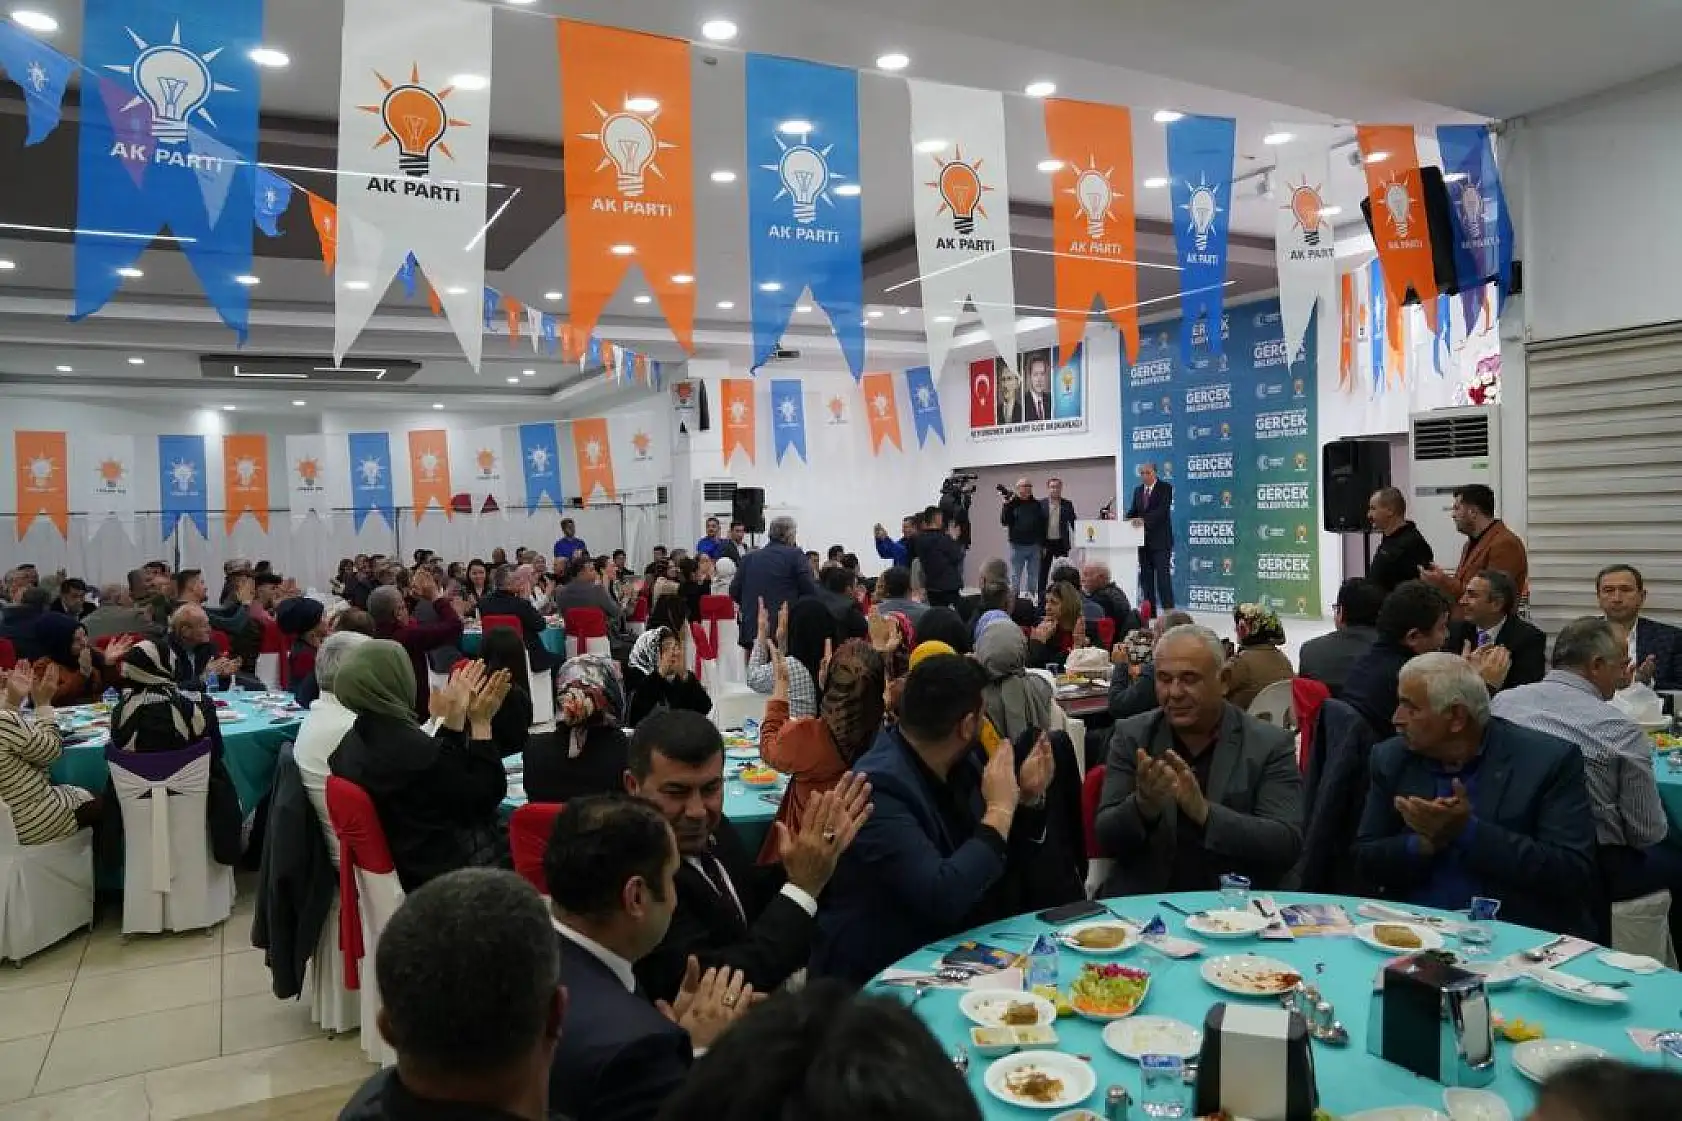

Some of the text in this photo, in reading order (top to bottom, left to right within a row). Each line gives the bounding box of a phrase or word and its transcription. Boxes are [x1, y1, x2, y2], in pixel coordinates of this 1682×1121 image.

[109, 141, 147, 162] AK
[366, 177, 398, 194] AK
[591, 198, 616, 212] AK
[769, 225, 791, 239] AK
[936, 237, 955, 249] AK
[1070, 241, 1087, 253] AK
[1186, 254, 1198, 264] AK
[1290, 249, 1305, 260] AK
[1255, 412, 1308, 431] GERÇEK
[1187, 456, 1233, 472] GERÇEK
[1256, 486, 1309, 502] GERÇEK
[1189, 523, 1234, 538] GERÇEK
[1257, 557, 1310, 572] GERÇEK
[1189, 589, 1234, 604] GERÇEK
